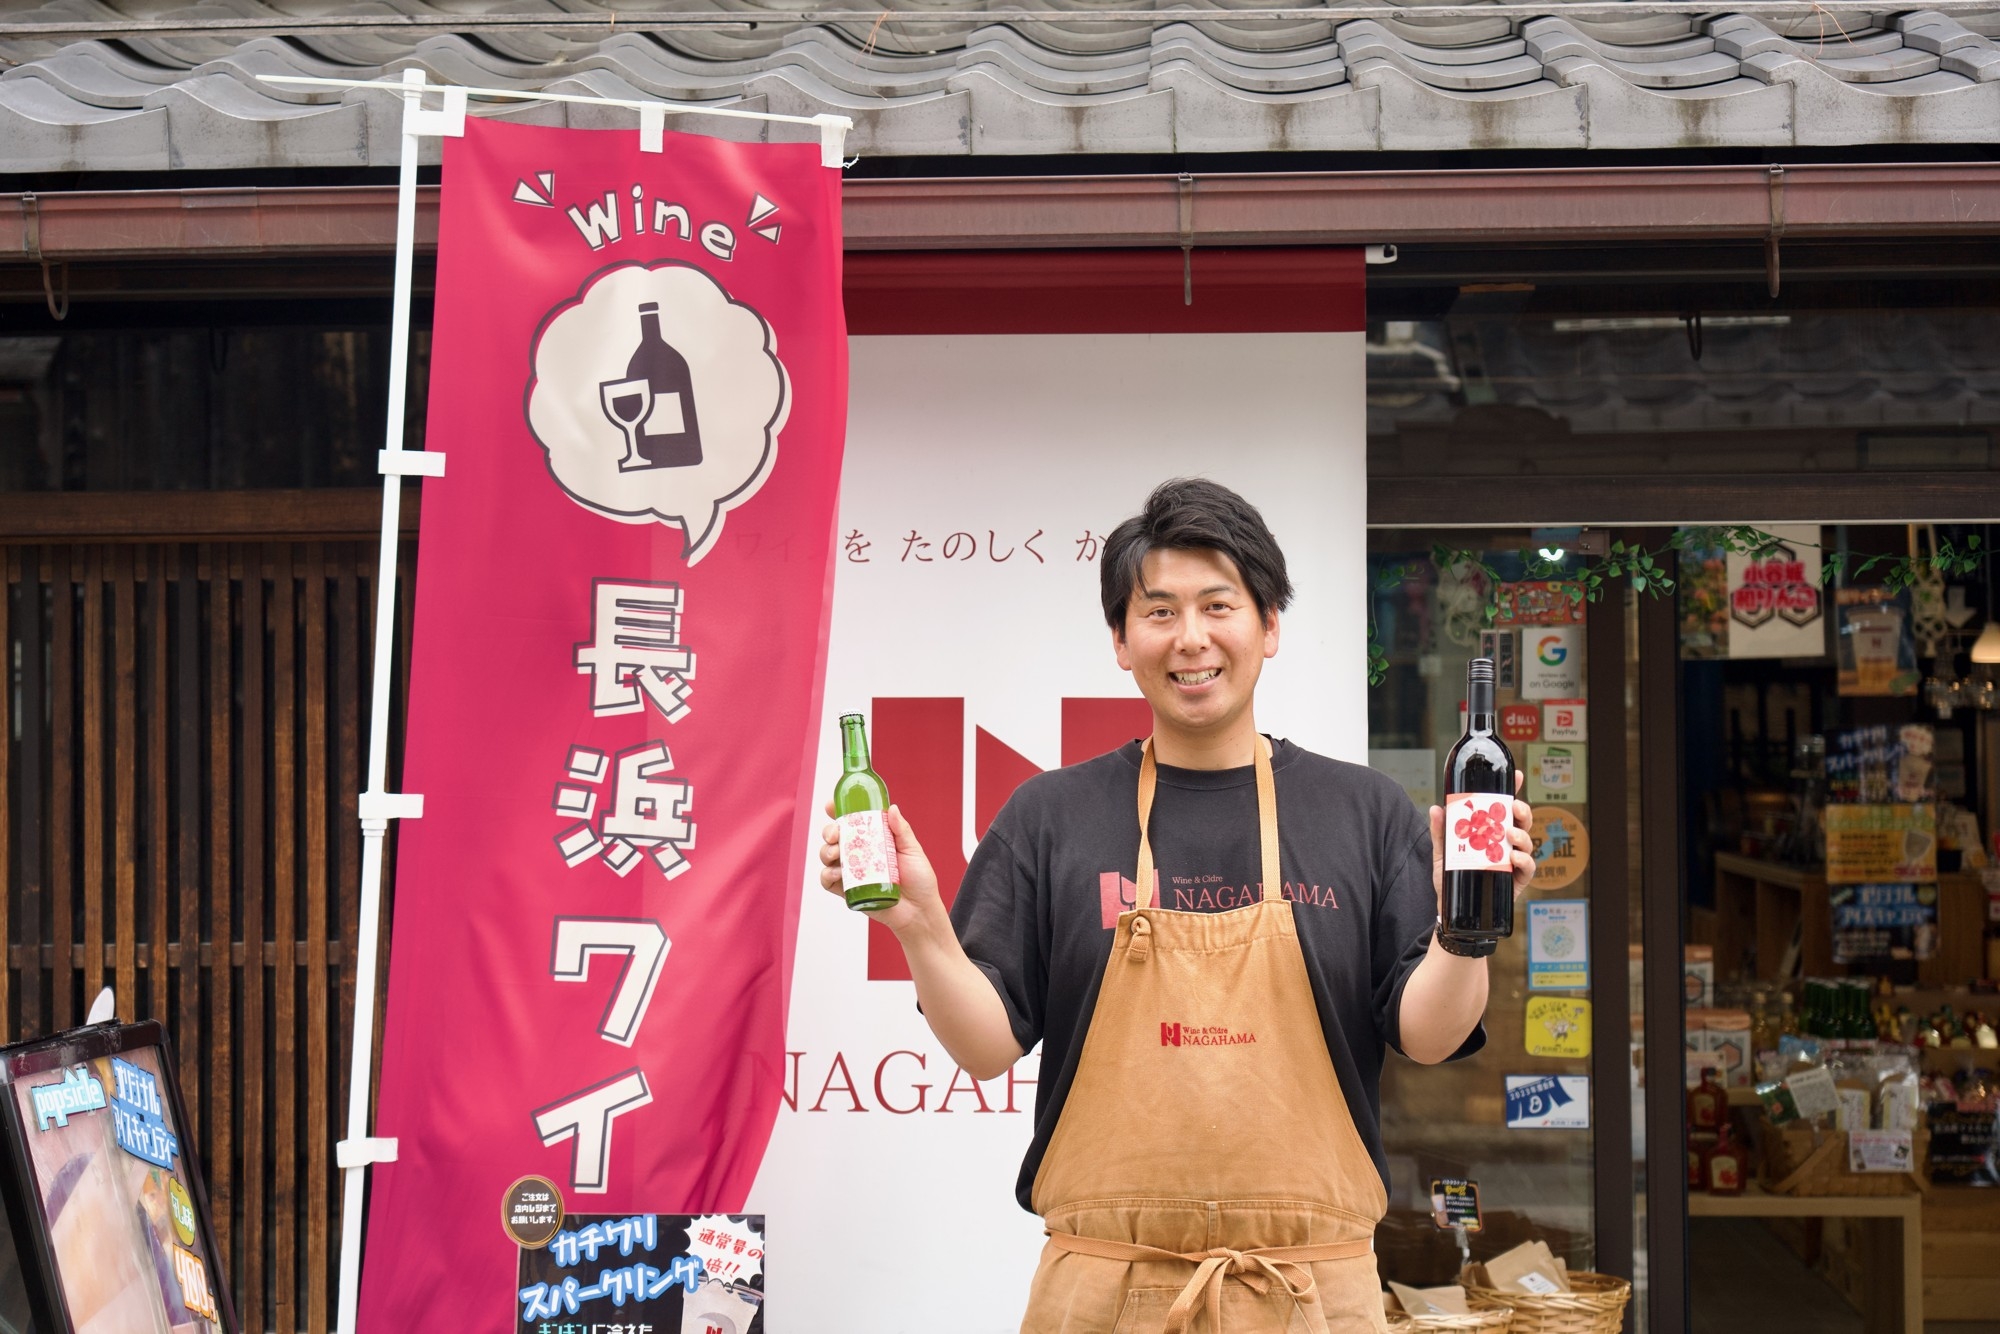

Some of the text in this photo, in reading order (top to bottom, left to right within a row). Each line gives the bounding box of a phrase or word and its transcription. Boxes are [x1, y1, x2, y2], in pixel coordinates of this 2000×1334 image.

[565, 183, 737, 261] Wine
[901, 529, 1045, 564] たのしく
[1529, 678, 1575, 691] on Google
[1551, 728, 1579, 737] PayPay
[1172, 874, 1224, 885] Wine & Cidre
[1182, 1026, 1228, 1035] Wine & Cidre
[1182, 1033, 1257, 1046] NAGAHAMA
[35, 1082, 101, 1131] popsicle
[115, 1064, 160, 1117] オリジナル
[114, 1106, 177, 1164] アイスキャンディー
[514, 1203, 557, 1213] 店内レジまで
[521, 1192, 549, 1202] ご注文は
[552, 1216, 658, 1264] カチワリ
[698, 1227, 763, 1261] 通常量の
[522, 1259, 700, 1319] スパークリング
